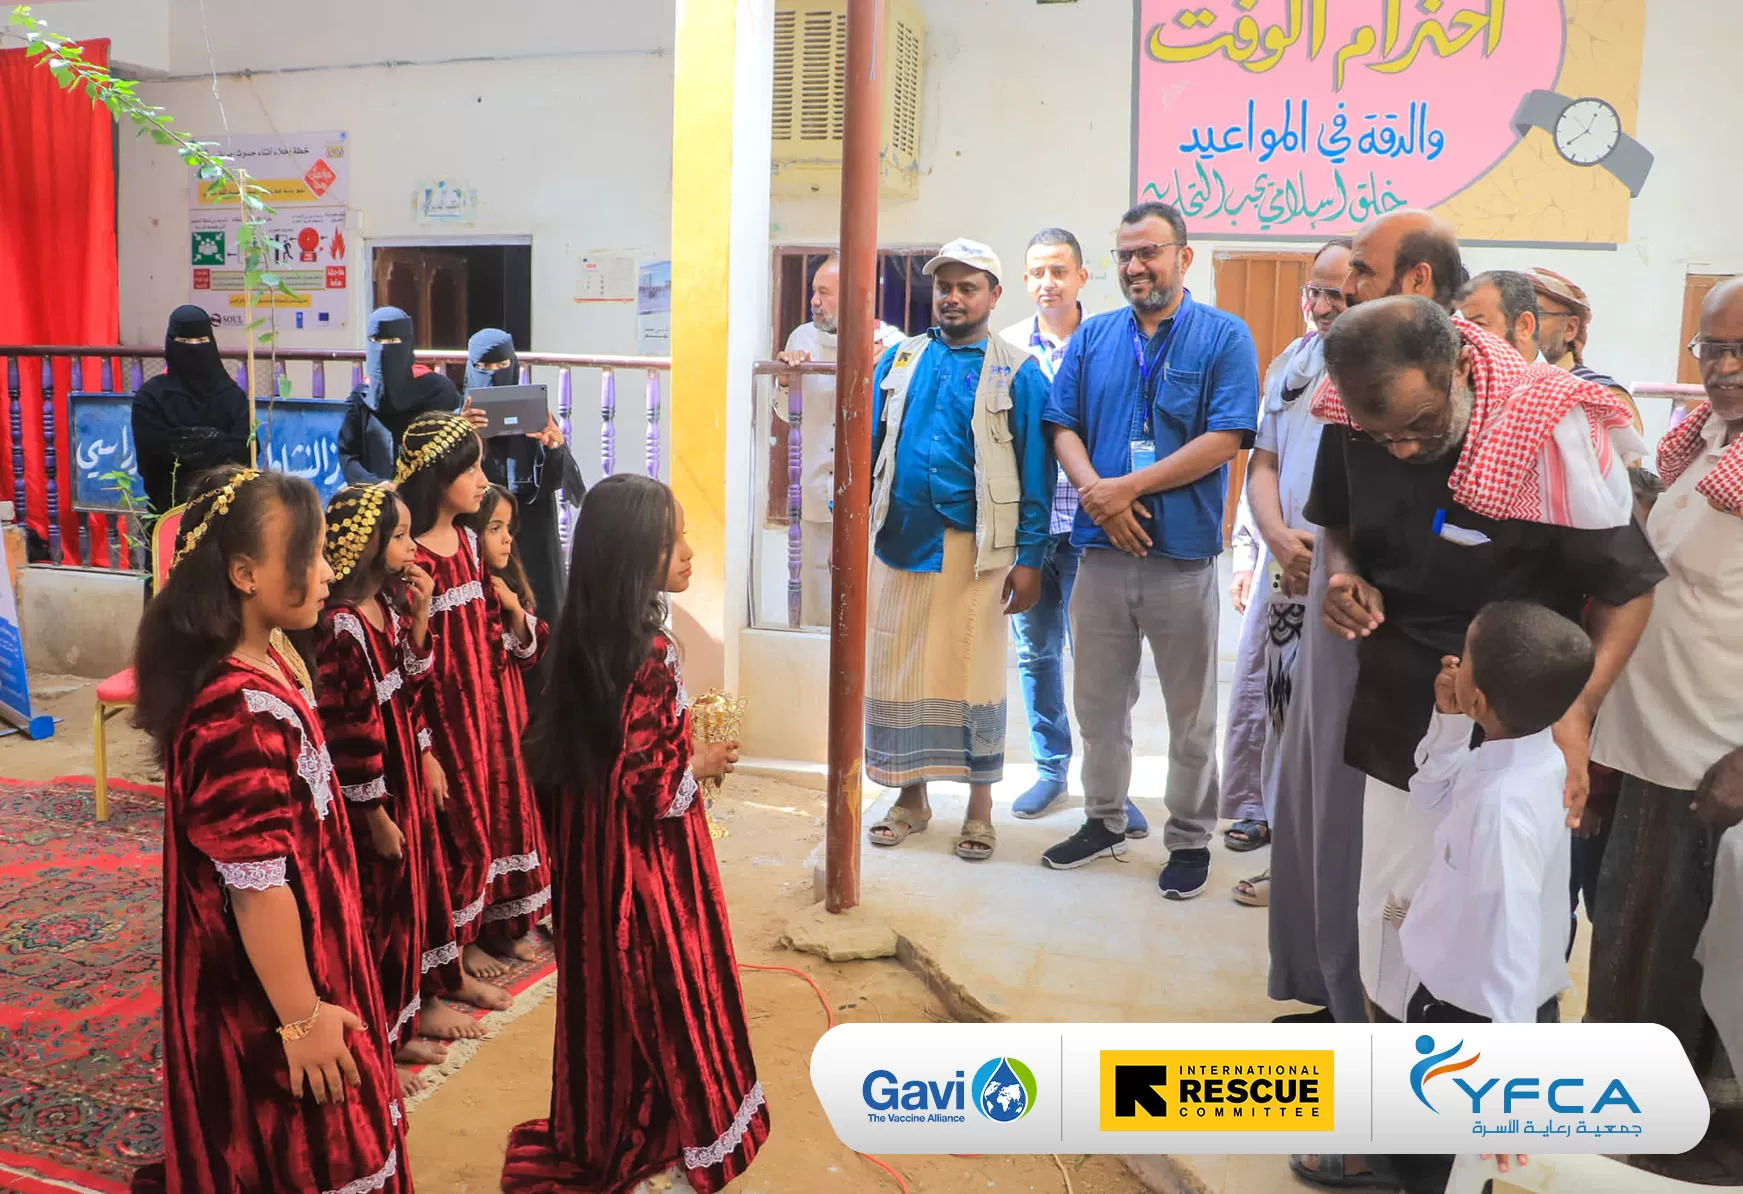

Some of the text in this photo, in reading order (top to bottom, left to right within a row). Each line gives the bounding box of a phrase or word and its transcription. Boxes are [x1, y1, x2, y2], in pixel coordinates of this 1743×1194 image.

[1146, 0, 1327, 73] الوقت
[1178, 98, 1445, 163] والدقة في المواعيد
[1349, 169, 1408, 223] خلق
